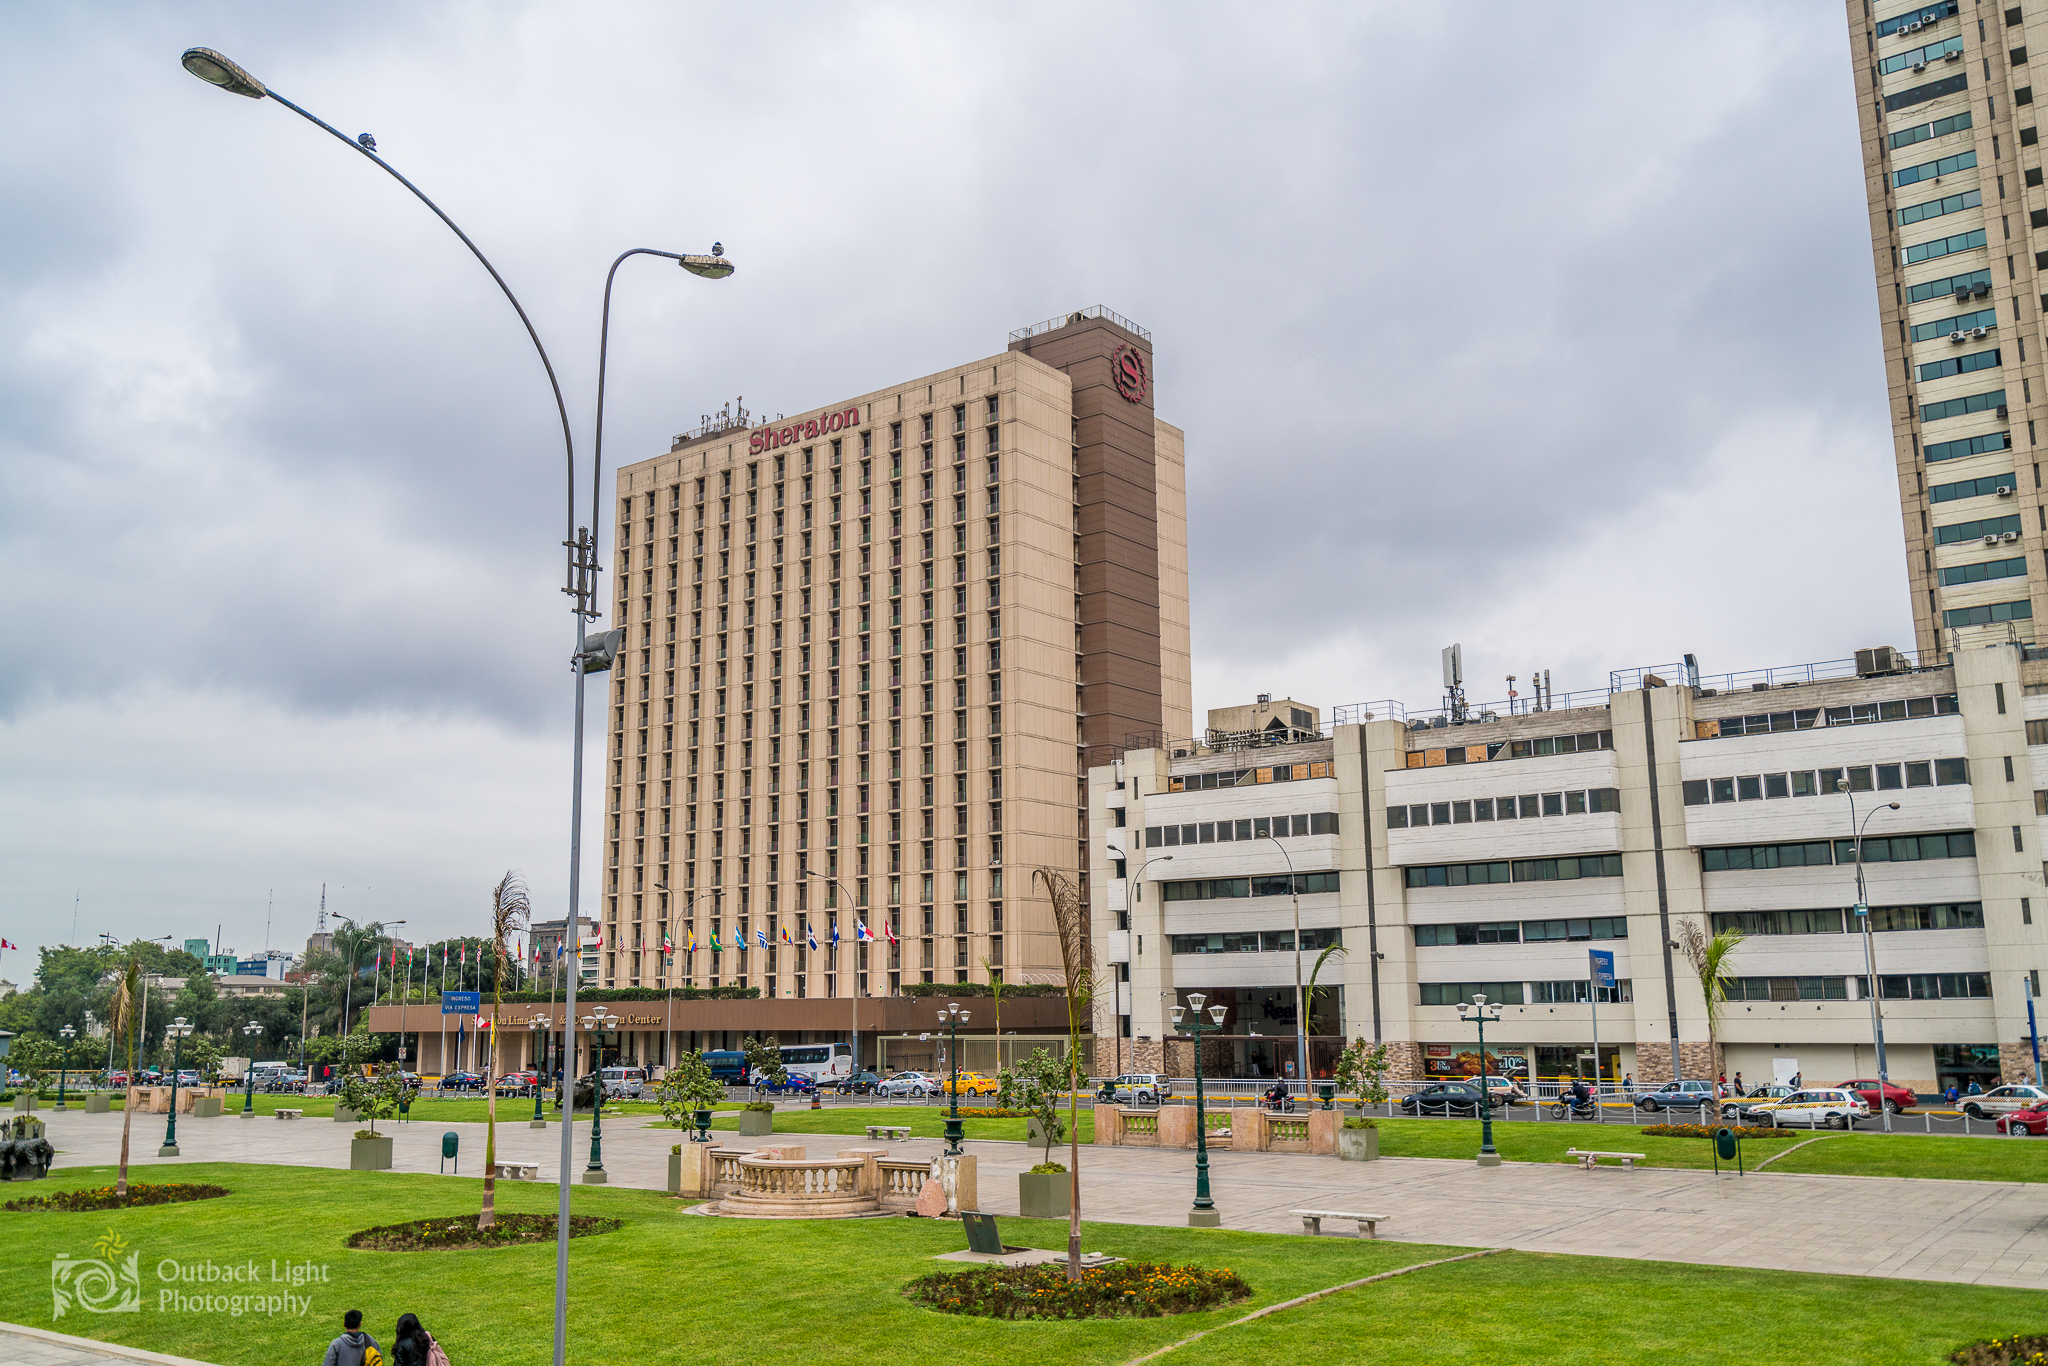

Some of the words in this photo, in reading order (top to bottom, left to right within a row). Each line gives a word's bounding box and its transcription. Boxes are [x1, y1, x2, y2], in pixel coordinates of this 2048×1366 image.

[749, 407, 860, 456] Sheraton
[1264, 1003, 1297, 1020] Real
[508, 1015, 529, 1025] Lima
[628, 1013, 662, 1024] Center
[1430, 1060, 1438, 1071] 3
